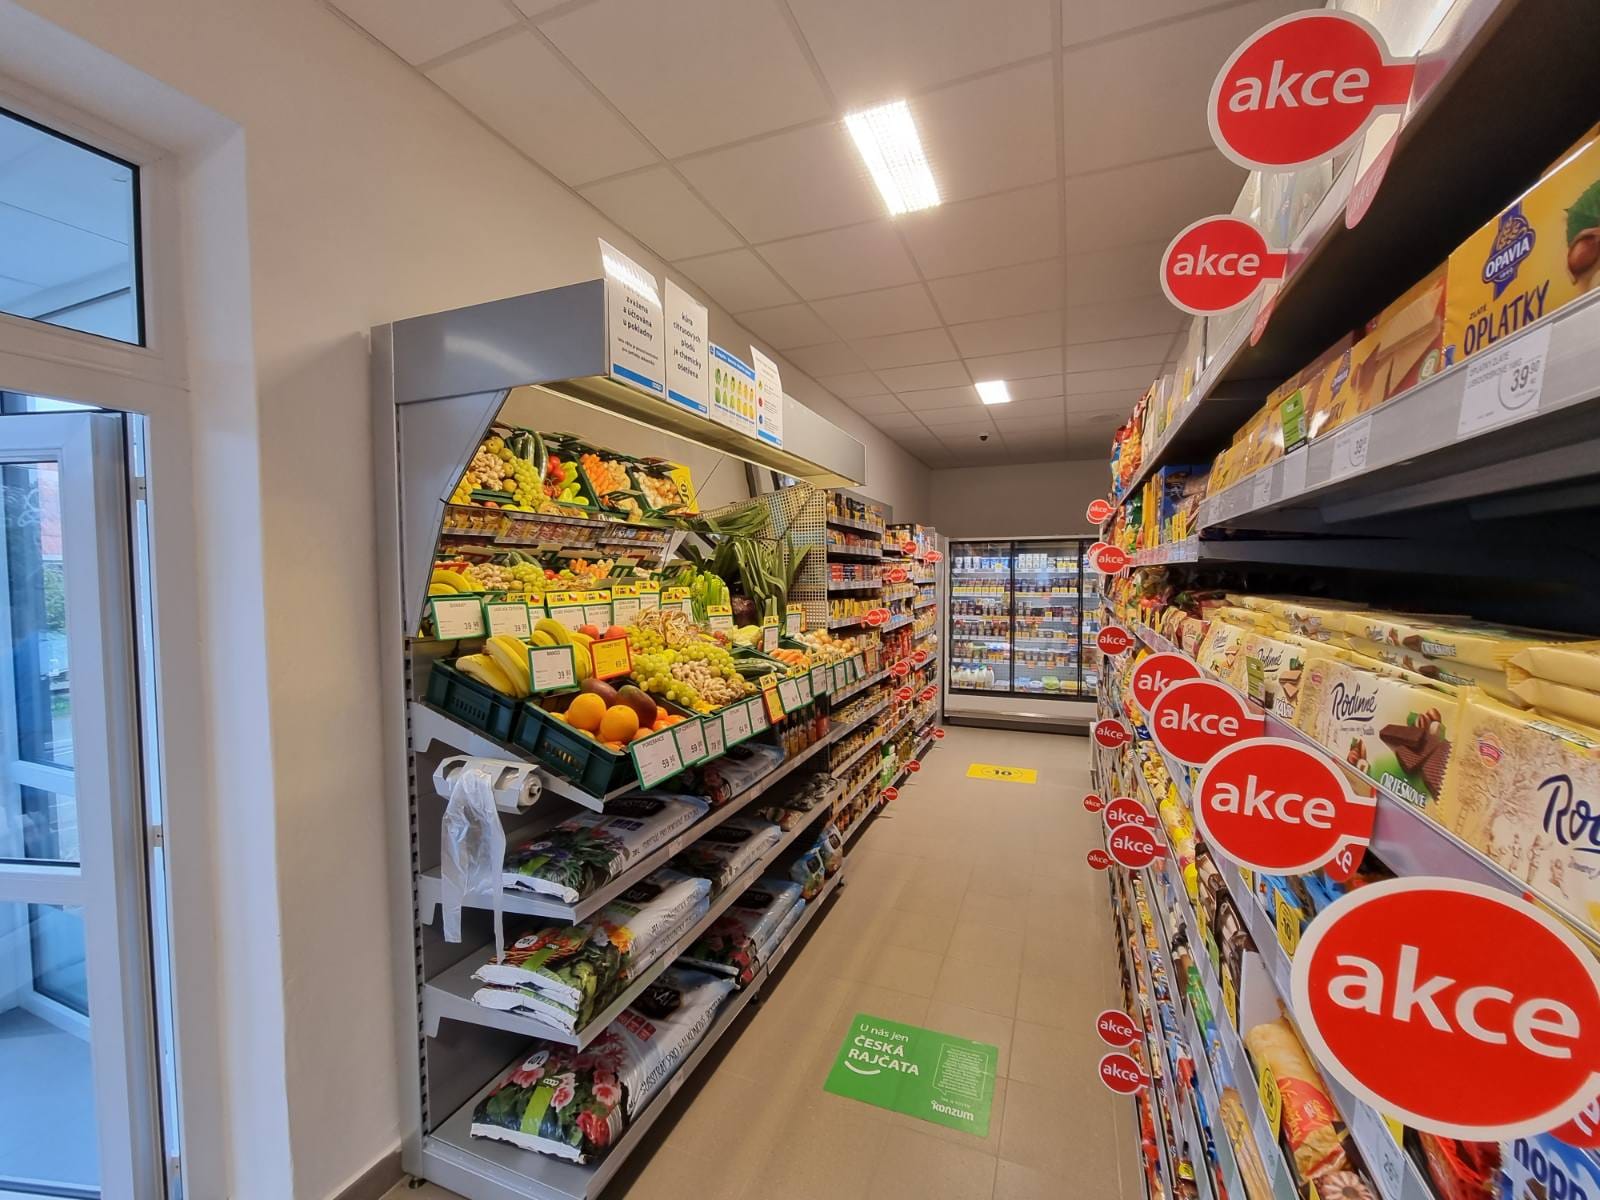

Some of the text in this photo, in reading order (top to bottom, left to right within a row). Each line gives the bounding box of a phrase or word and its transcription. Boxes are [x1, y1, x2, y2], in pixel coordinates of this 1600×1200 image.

[1228, 59, 1370, 113] akce
[1173, 245, 1260, 276] akce
[1485, 237, 1530, 278] OPAVIA
[1463, 279, 1550, 356] OPLATKY
[627, 322, 653, 341] pokladny
[680, 351, 702, 370] chemicky
[1510, 365, 1529, 392] 39
[1090, 504, 1107, 513] akce
[1098, 553, 1124, 564] akce
[1100, 633, 1126, 646] akce
[1138, 670, 1170, 692] ak
[1330, 682, 1380, 721] Rodinné
[1159, 703, 1240, 737] akce
[1096, 727, 1124, 740] akce
[1380, 772, 1426, 808] ORIEŠKOVÉ
[1084, 799, 1100, 808] akce
[1210, 775, 1336, 829] akce
[1108, 808, 1145, 825] akce
[1113, 835, 1154, 855] akce
[1088, 854, 1109, 864] akce
[1327, 944, 1581, 1059] akce
[860, 1023, 909, 1043] U nás jen
[1100, 1020, 1133, 1037] akce
[854, 1034, 905, 1058] ČESKÁ
[848, 1048, 920, 1076] RAJČATA
[1103, 1063, 1139, 1083] akce
[933, 1102, 974, 1121] konzum
